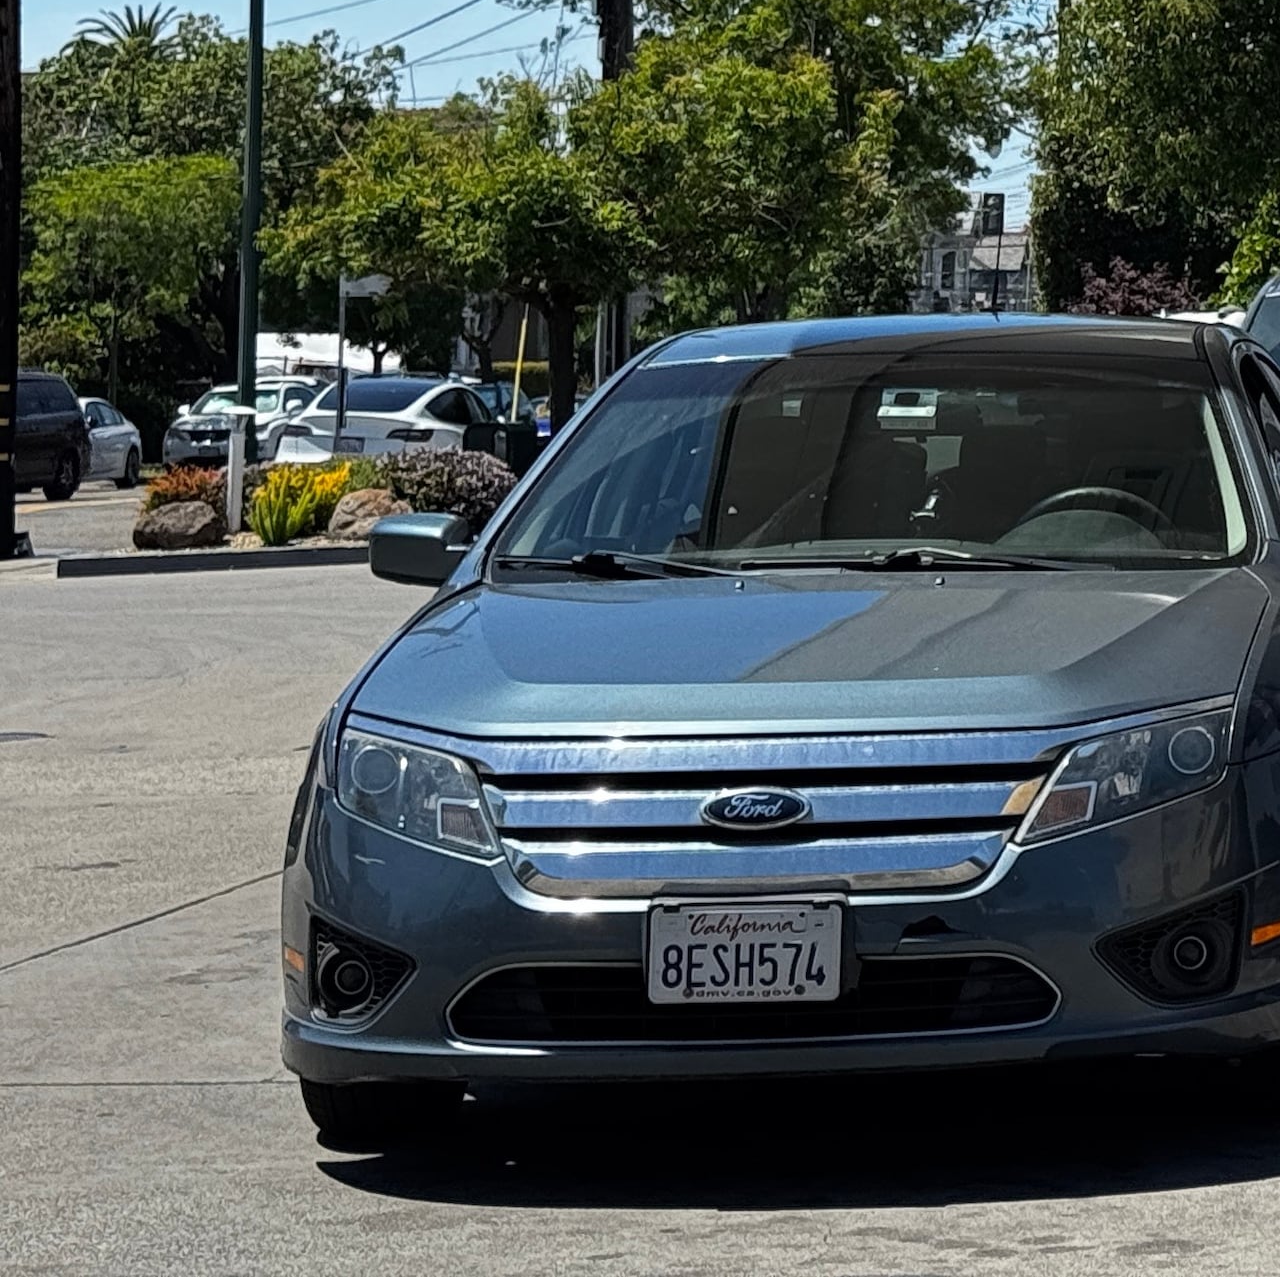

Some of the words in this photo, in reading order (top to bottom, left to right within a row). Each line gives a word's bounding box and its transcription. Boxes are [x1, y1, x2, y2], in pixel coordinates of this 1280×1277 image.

[724, 794, 784, 818] Ford
[690, 913, 804, 941] California
[661, 942, 827, 989] 8ESH574
[696, 988, 792, 998] dmv.ca.gov
